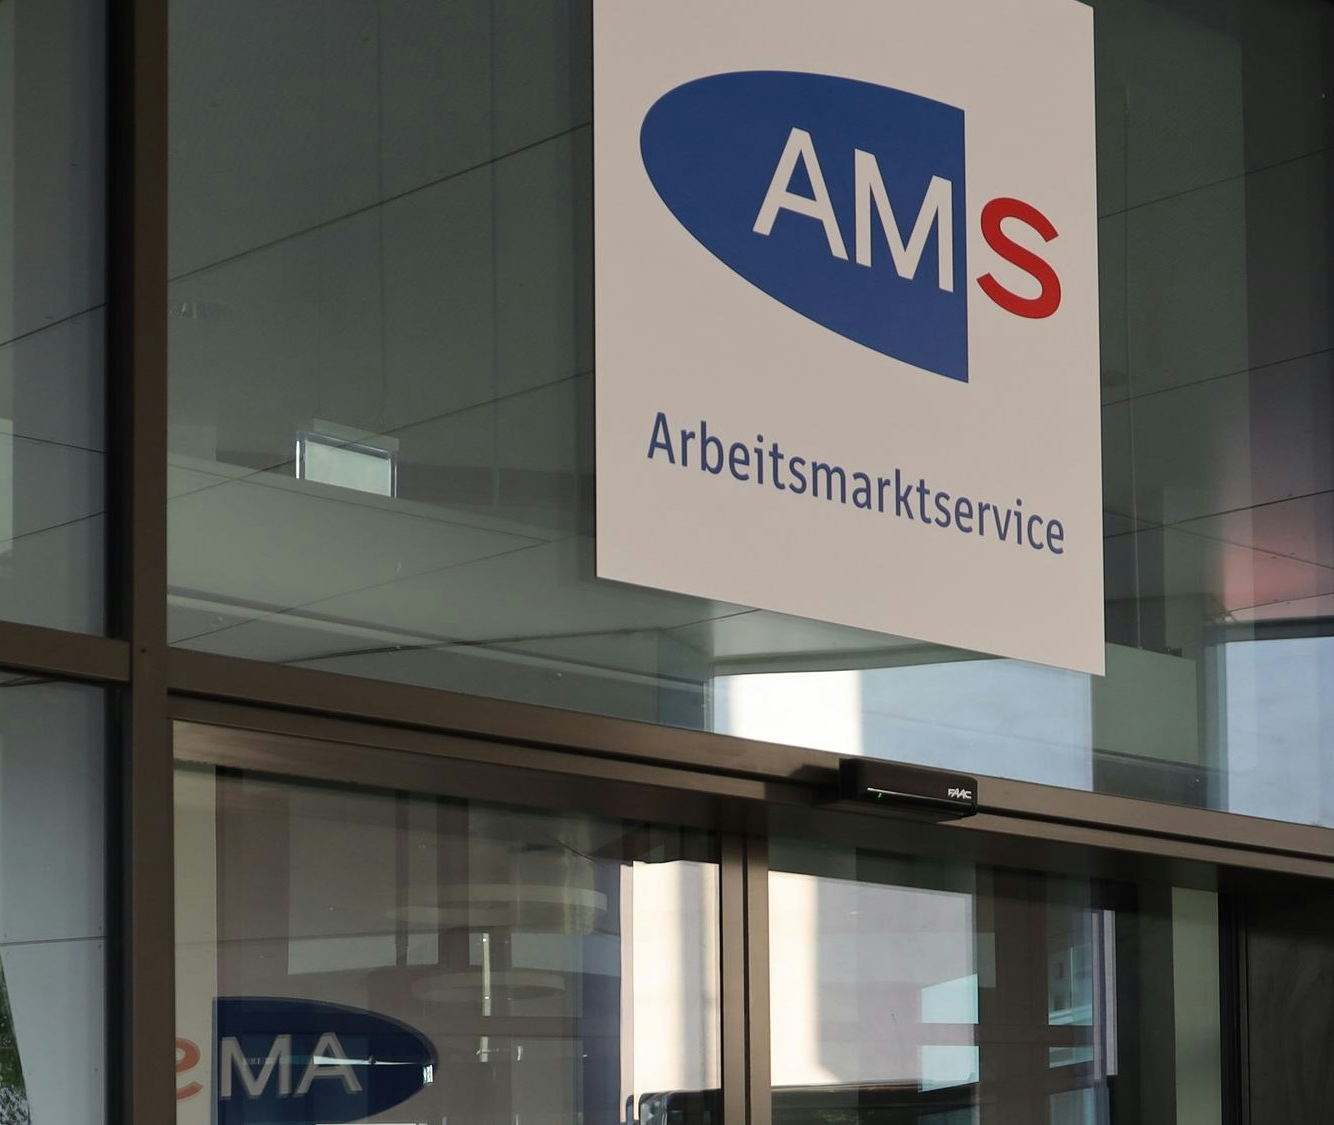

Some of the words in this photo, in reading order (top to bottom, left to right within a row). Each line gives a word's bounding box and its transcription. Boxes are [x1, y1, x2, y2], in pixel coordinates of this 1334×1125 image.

[752, 126, 1062, 319] AMS
[647, 411, 1065, 555] Arbeitsmarktservice
[947, 787, 972, 800] FAAC
